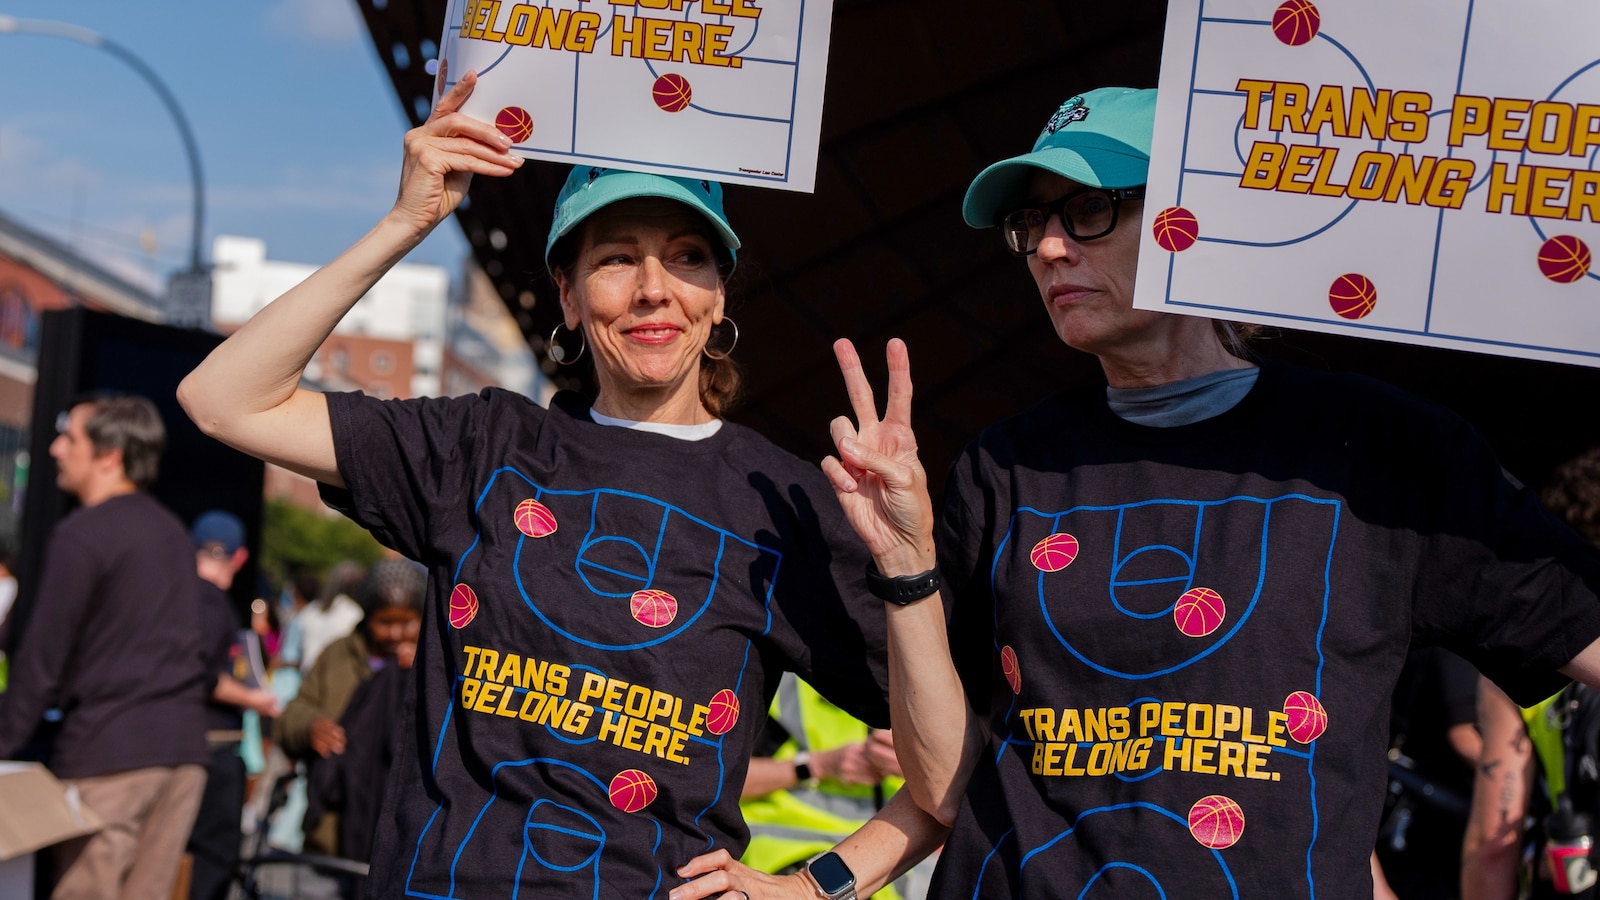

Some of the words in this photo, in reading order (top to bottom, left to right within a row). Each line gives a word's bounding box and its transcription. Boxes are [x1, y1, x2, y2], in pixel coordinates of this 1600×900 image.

[459, 0, 602, 54] BELONG
[611, 15, 743, 69] HERE.
[1235, 79, 1432, 143] TRANS
[1239, 141, 1476, 209] BELONG
[461, 678, 595, 735] BELONG
[597, 710, 690, 766] HERE.
[463, 645, 571, 696] TRANS
[578, 671, 712, 737] PEOPLE
[1019, 707, 1131, 742] TRANS
[1139, 701, 1290, 748] PEOPLE
[1031, 736, 1154, 777] BELONG
[1162, 737, 1281, 781] HERE.
